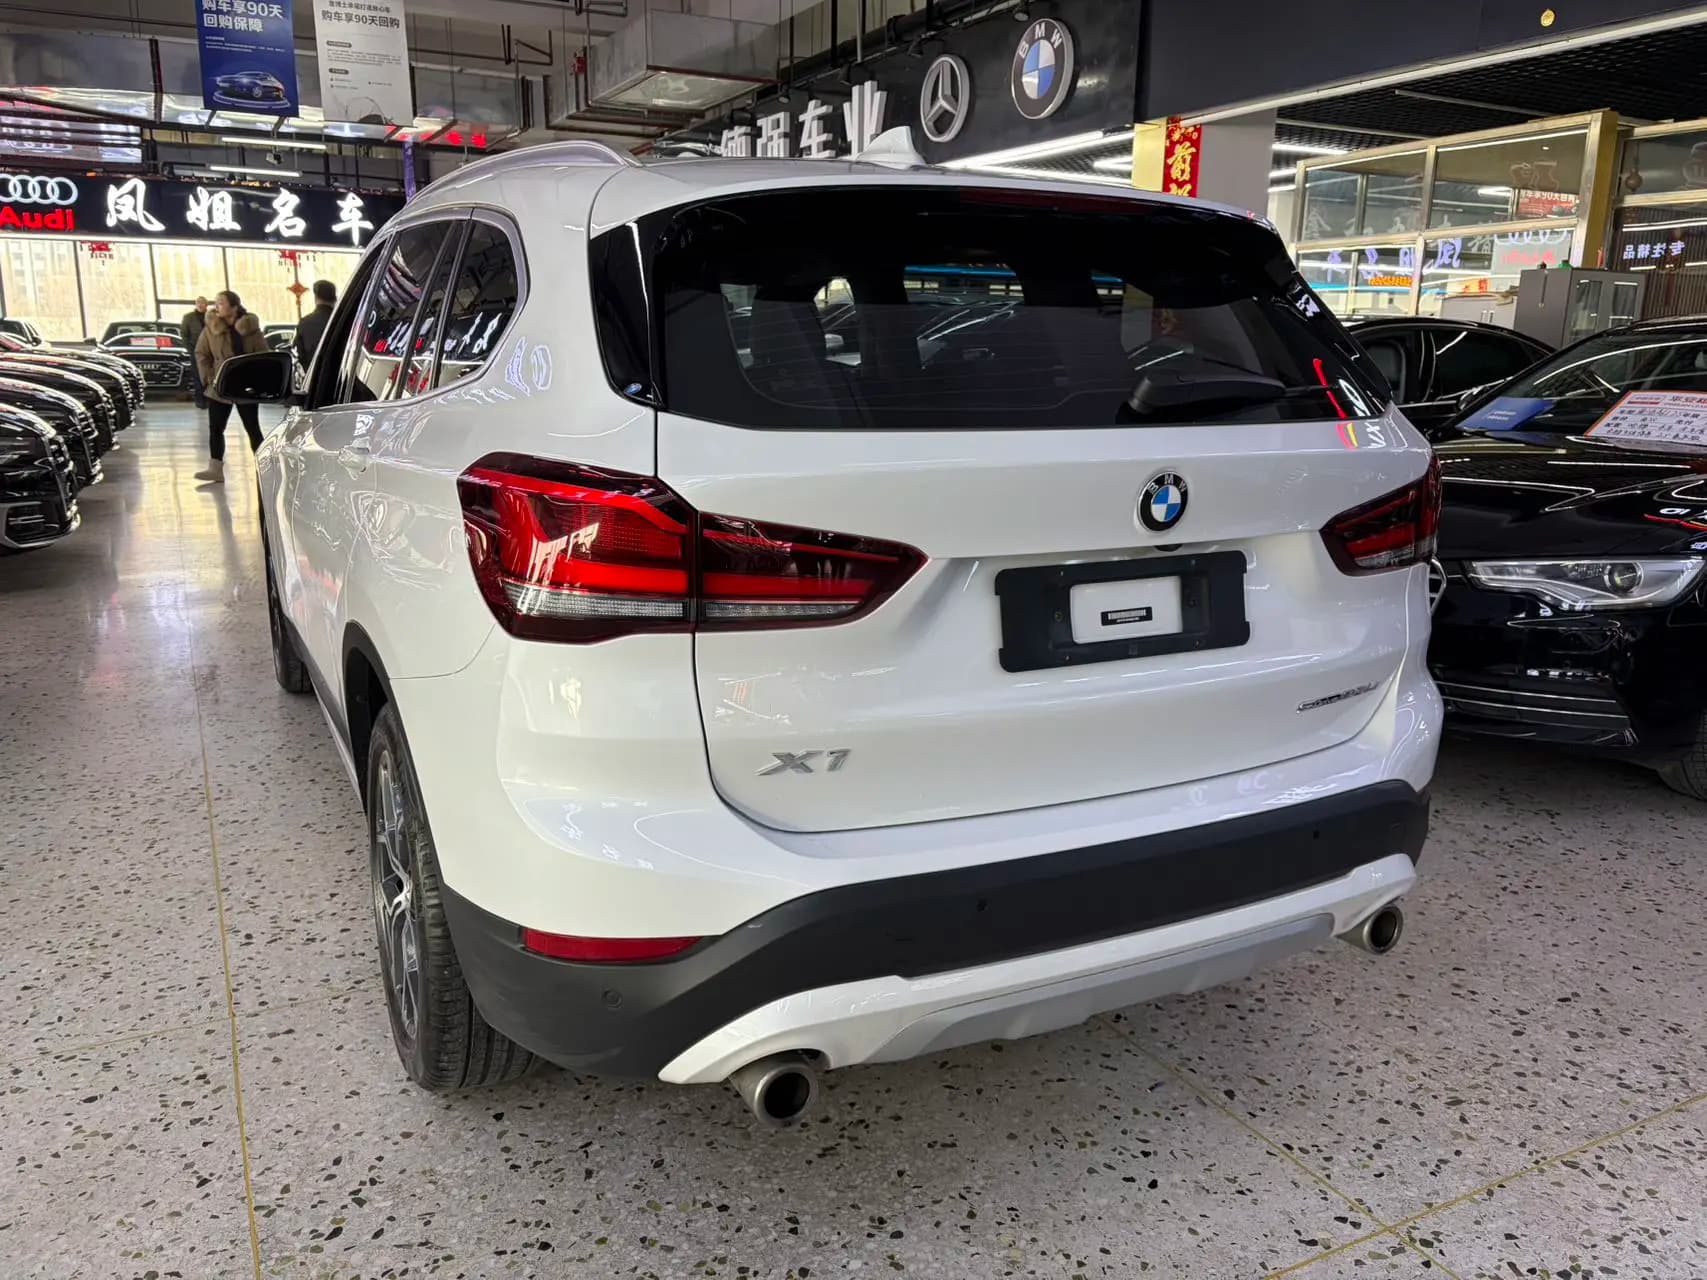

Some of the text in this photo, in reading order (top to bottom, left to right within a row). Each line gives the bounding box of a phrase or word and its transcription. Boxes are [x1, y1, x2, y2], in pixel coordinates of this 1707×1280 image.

[201, 0, 285, 20] 购车享90天
[321, 9, 400, 29] 购车享90天回购
[203, 13, 264, 33] 回购保障
[1017, 23, 1064, 60] BMW
[0, 205, 75, 231] Audi
[106, 177, 375, 246] 凤姐名车
[1147, 472, 1188, 494] BMW
